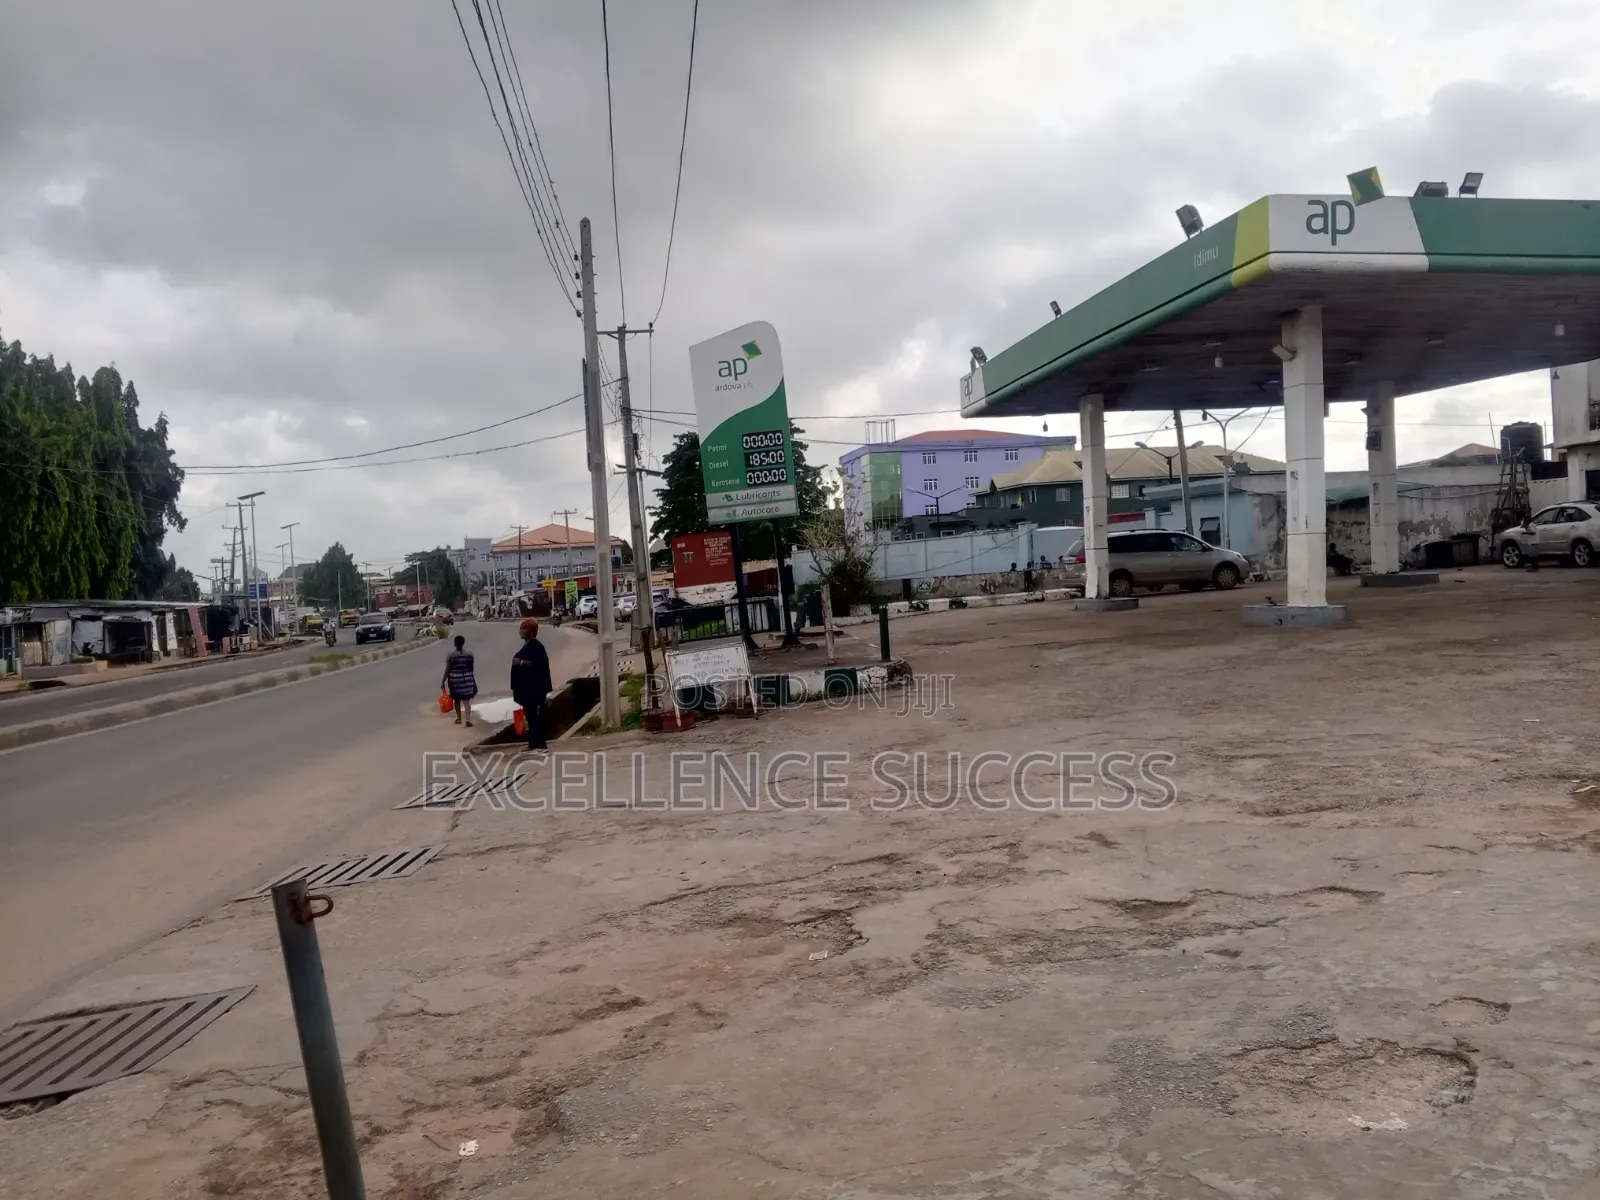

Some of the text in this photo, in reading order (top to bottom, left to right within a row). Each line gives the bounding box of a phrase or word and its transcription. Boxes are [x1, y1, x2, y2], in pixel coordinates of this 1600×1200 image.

[1305, 199, 1356, 246] ap
[1193, 245, 1219, 268] Idimu
[718, 357, 748, 381] ap
[714, 383, 742, 392] ardova
[964, 375, 973, 402] ap
[707, 443, 727, 453] Petrol
[708, 460, 729, 470] Diesel
[711, 478, 741, 488] Kerosene
[735, 489, 781, 501] Lubricants
[741, 506, 780, 516] Autocare
